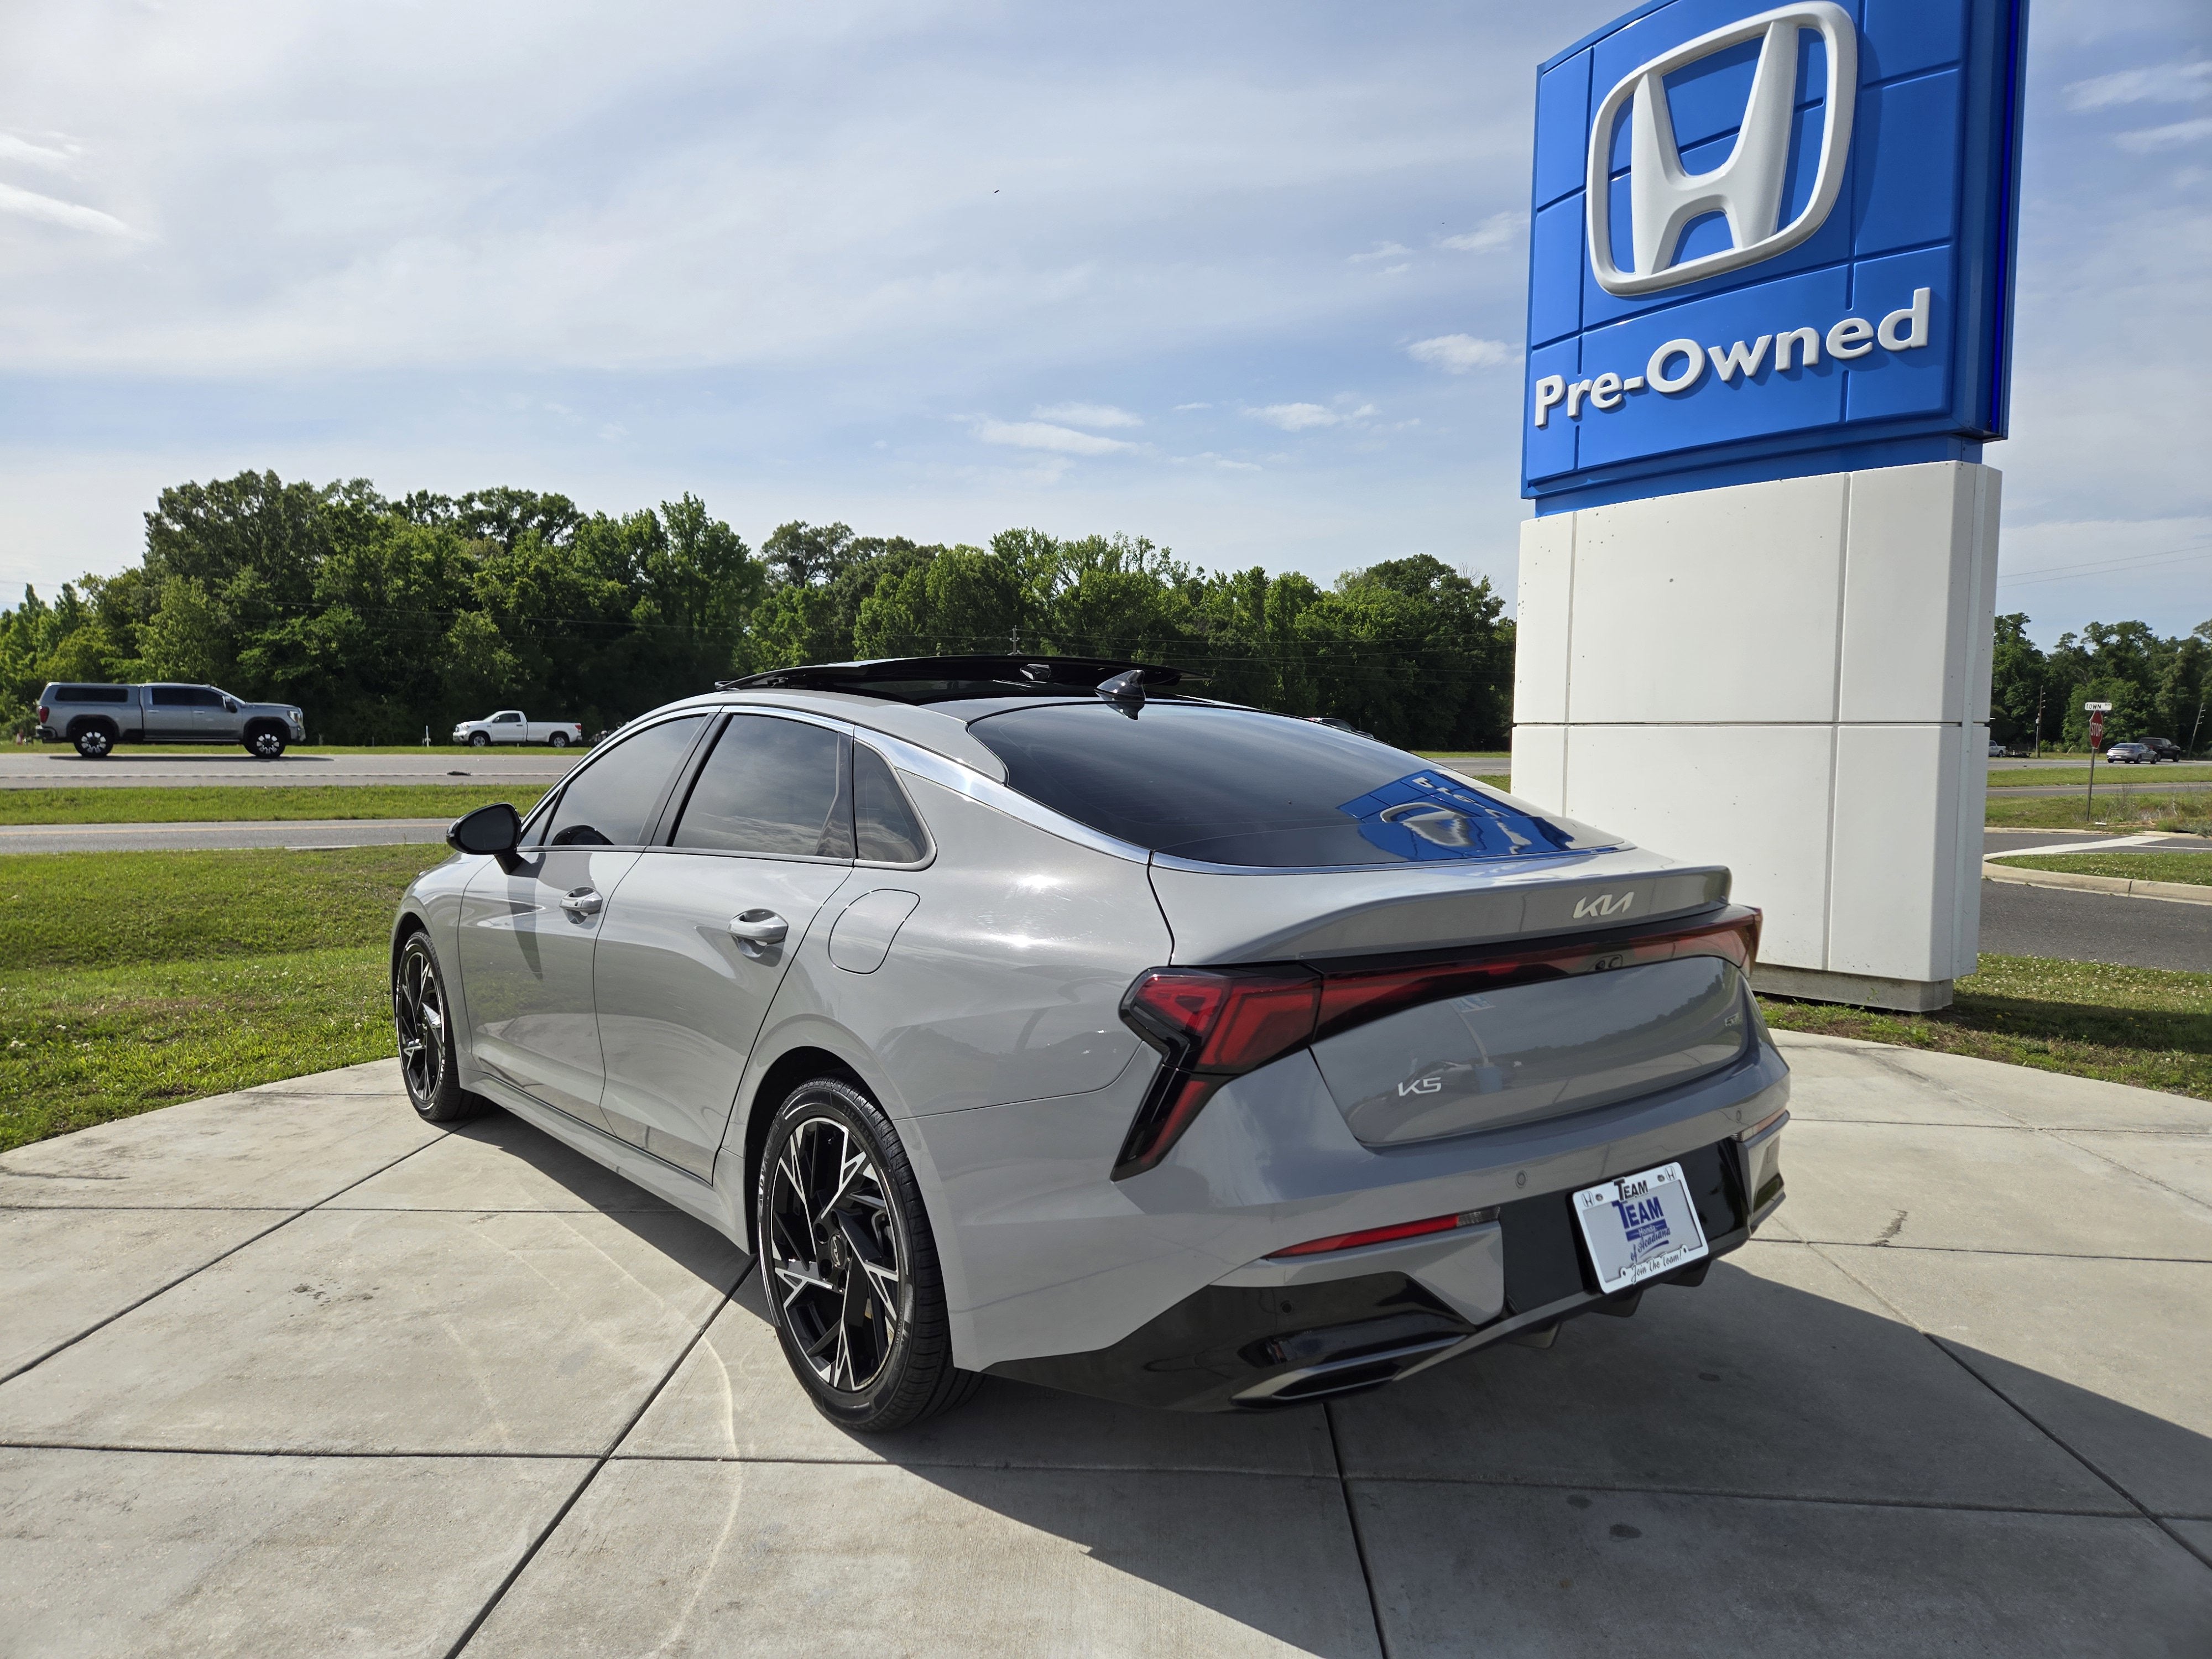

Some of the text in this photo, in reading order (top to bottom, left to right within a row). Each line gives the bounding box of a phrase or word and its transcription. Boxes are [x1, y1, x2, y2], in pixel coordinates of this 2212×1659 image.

[1534, 286, 1931, 427] Pre-Owned
[2091, 722, 2103, 737] STOP
[1398, 1076, 1442, 1097] K5
[1614, 1178, 1648, 1202] TEAM
[1611, 1196, 1665, 1229] TEAM
[1631, 1227, 1671, 1262] of Acadiana
[1631, 1248, 1682, 1283] Join The Team!
